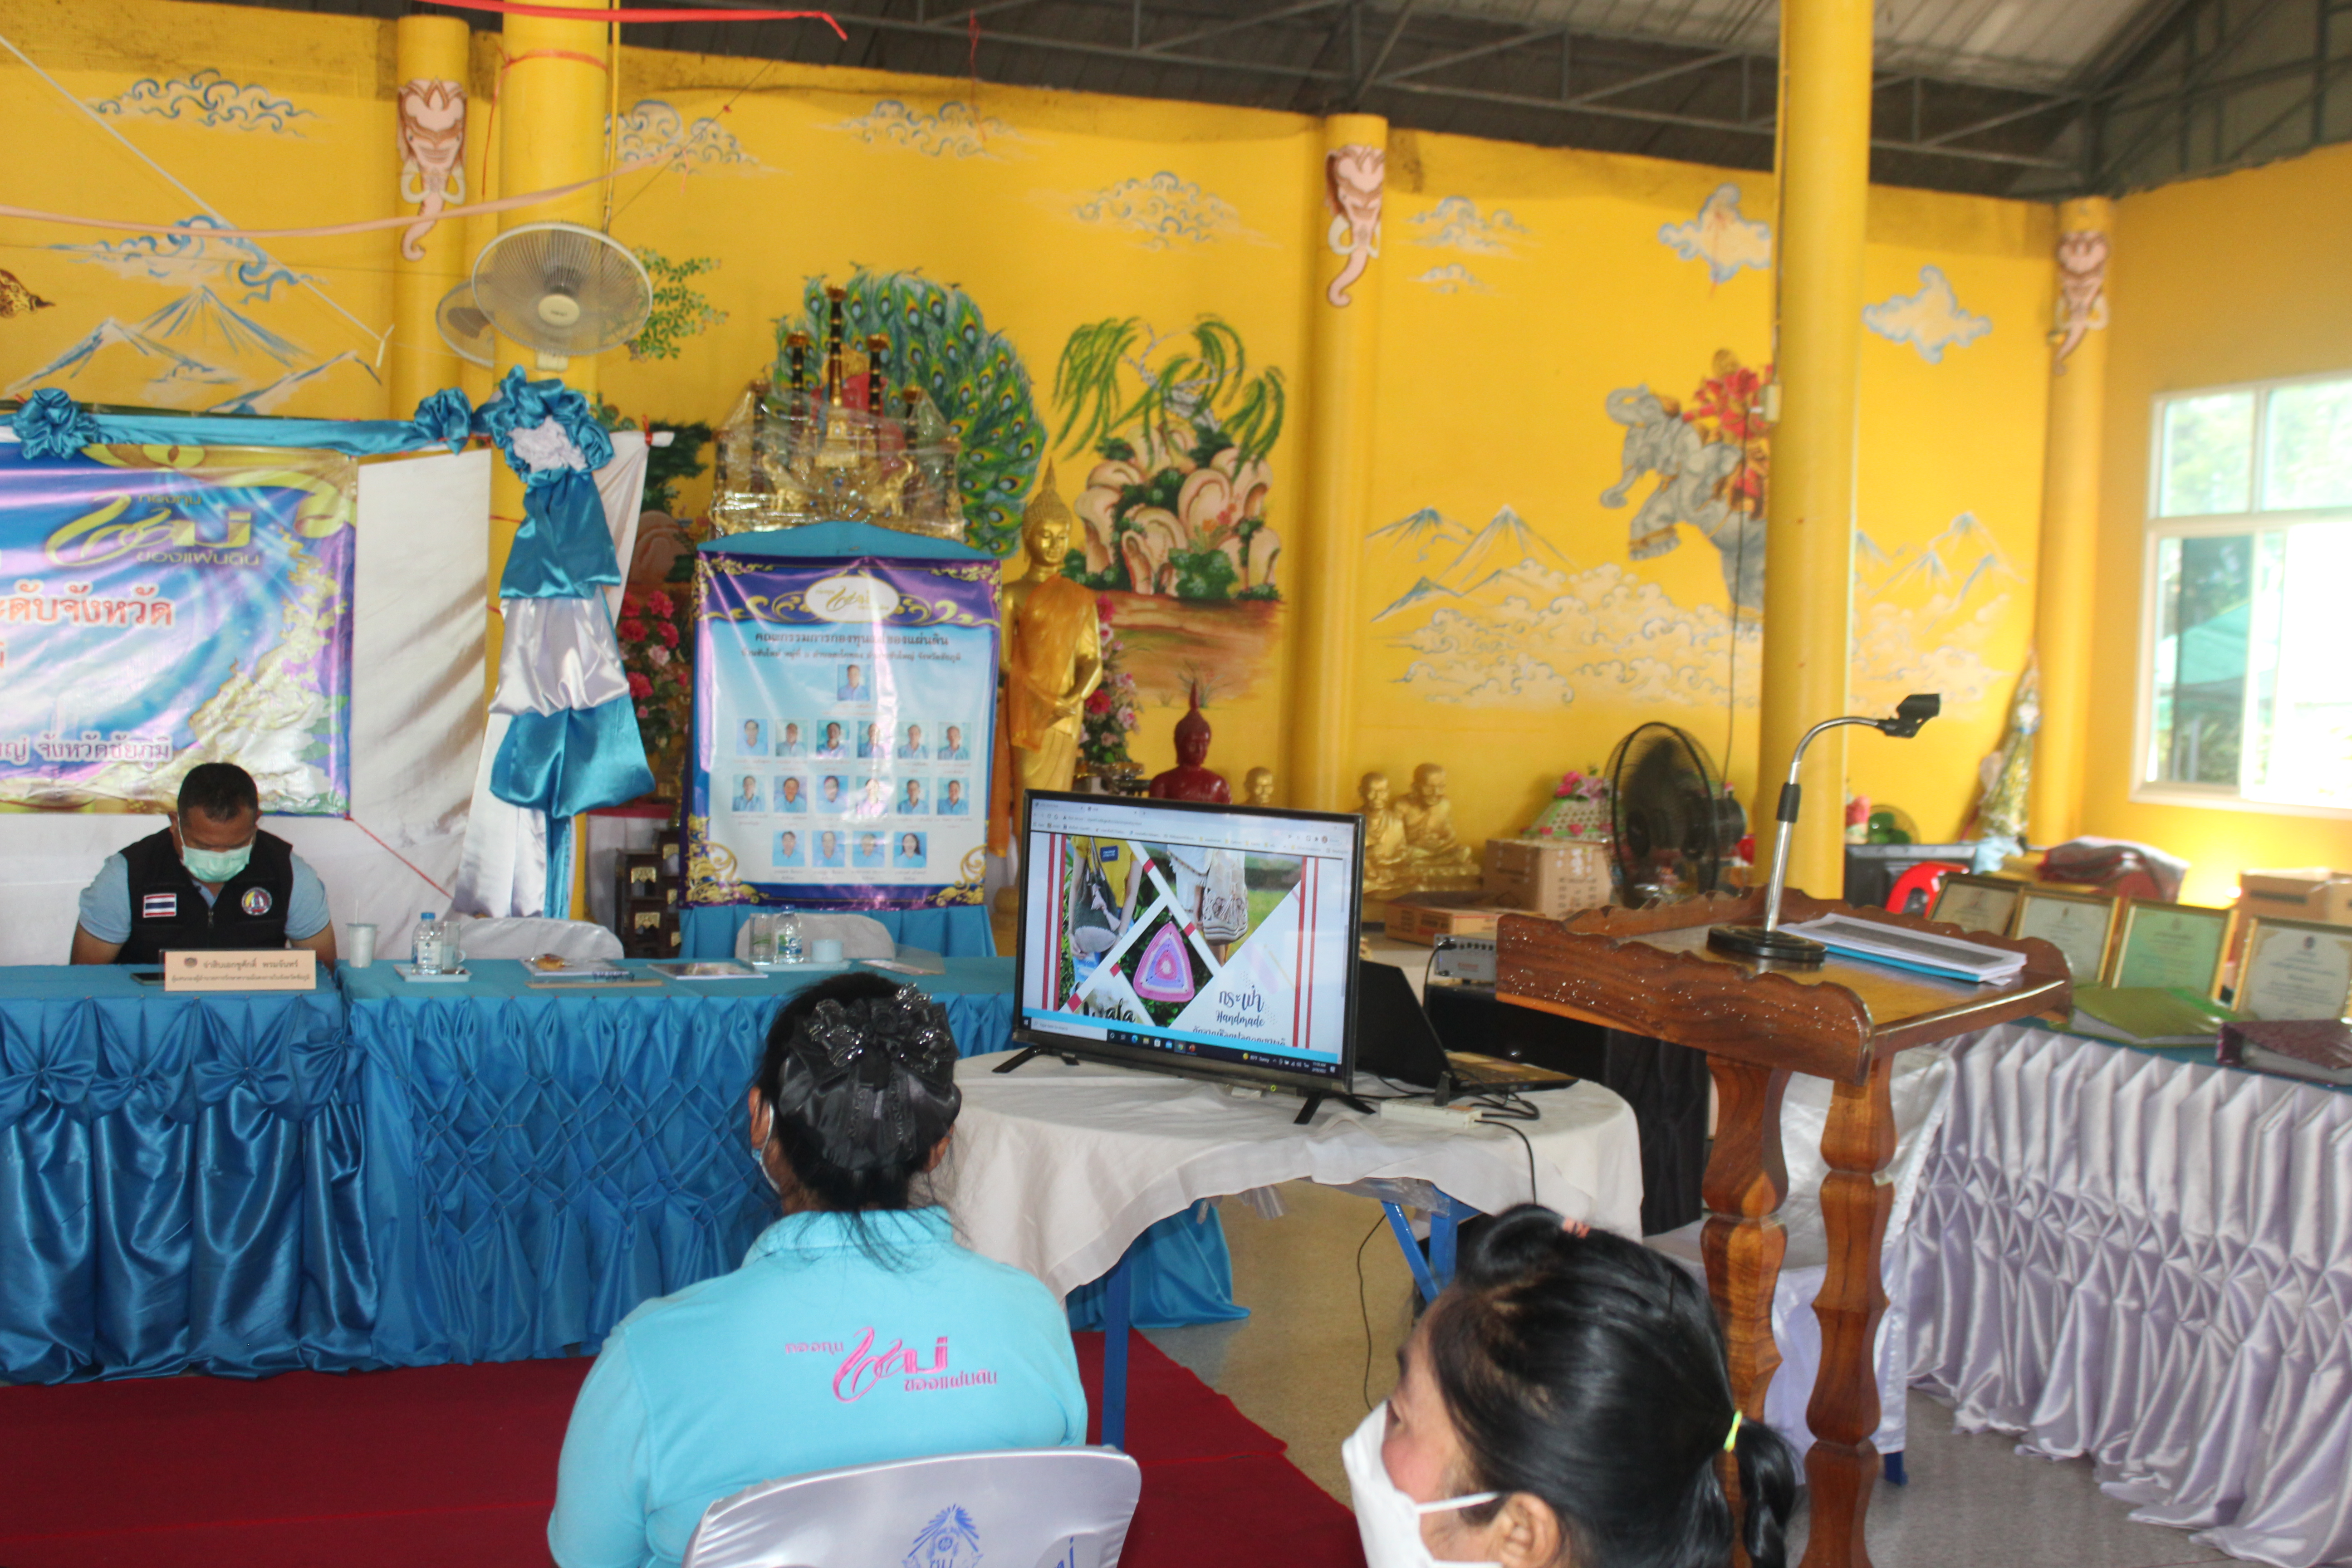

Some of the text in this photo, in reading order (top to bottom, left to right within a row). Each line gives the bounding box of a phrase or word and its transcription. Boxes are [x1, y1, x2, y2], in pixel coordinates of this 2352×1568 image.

[138, 494, 201, 507] กองทุน
[137, 549, 260, 566] ของแผ่นดิน
[0, 733, 170, 769] ญ่ จังหวัดชัยภูมิ
[1215, 1010, 1266, 1028] Handmade
[785, 1341, 844, 1355] กองทุน
[904, 1370, 997, 1392] ของแผ่นดิน
